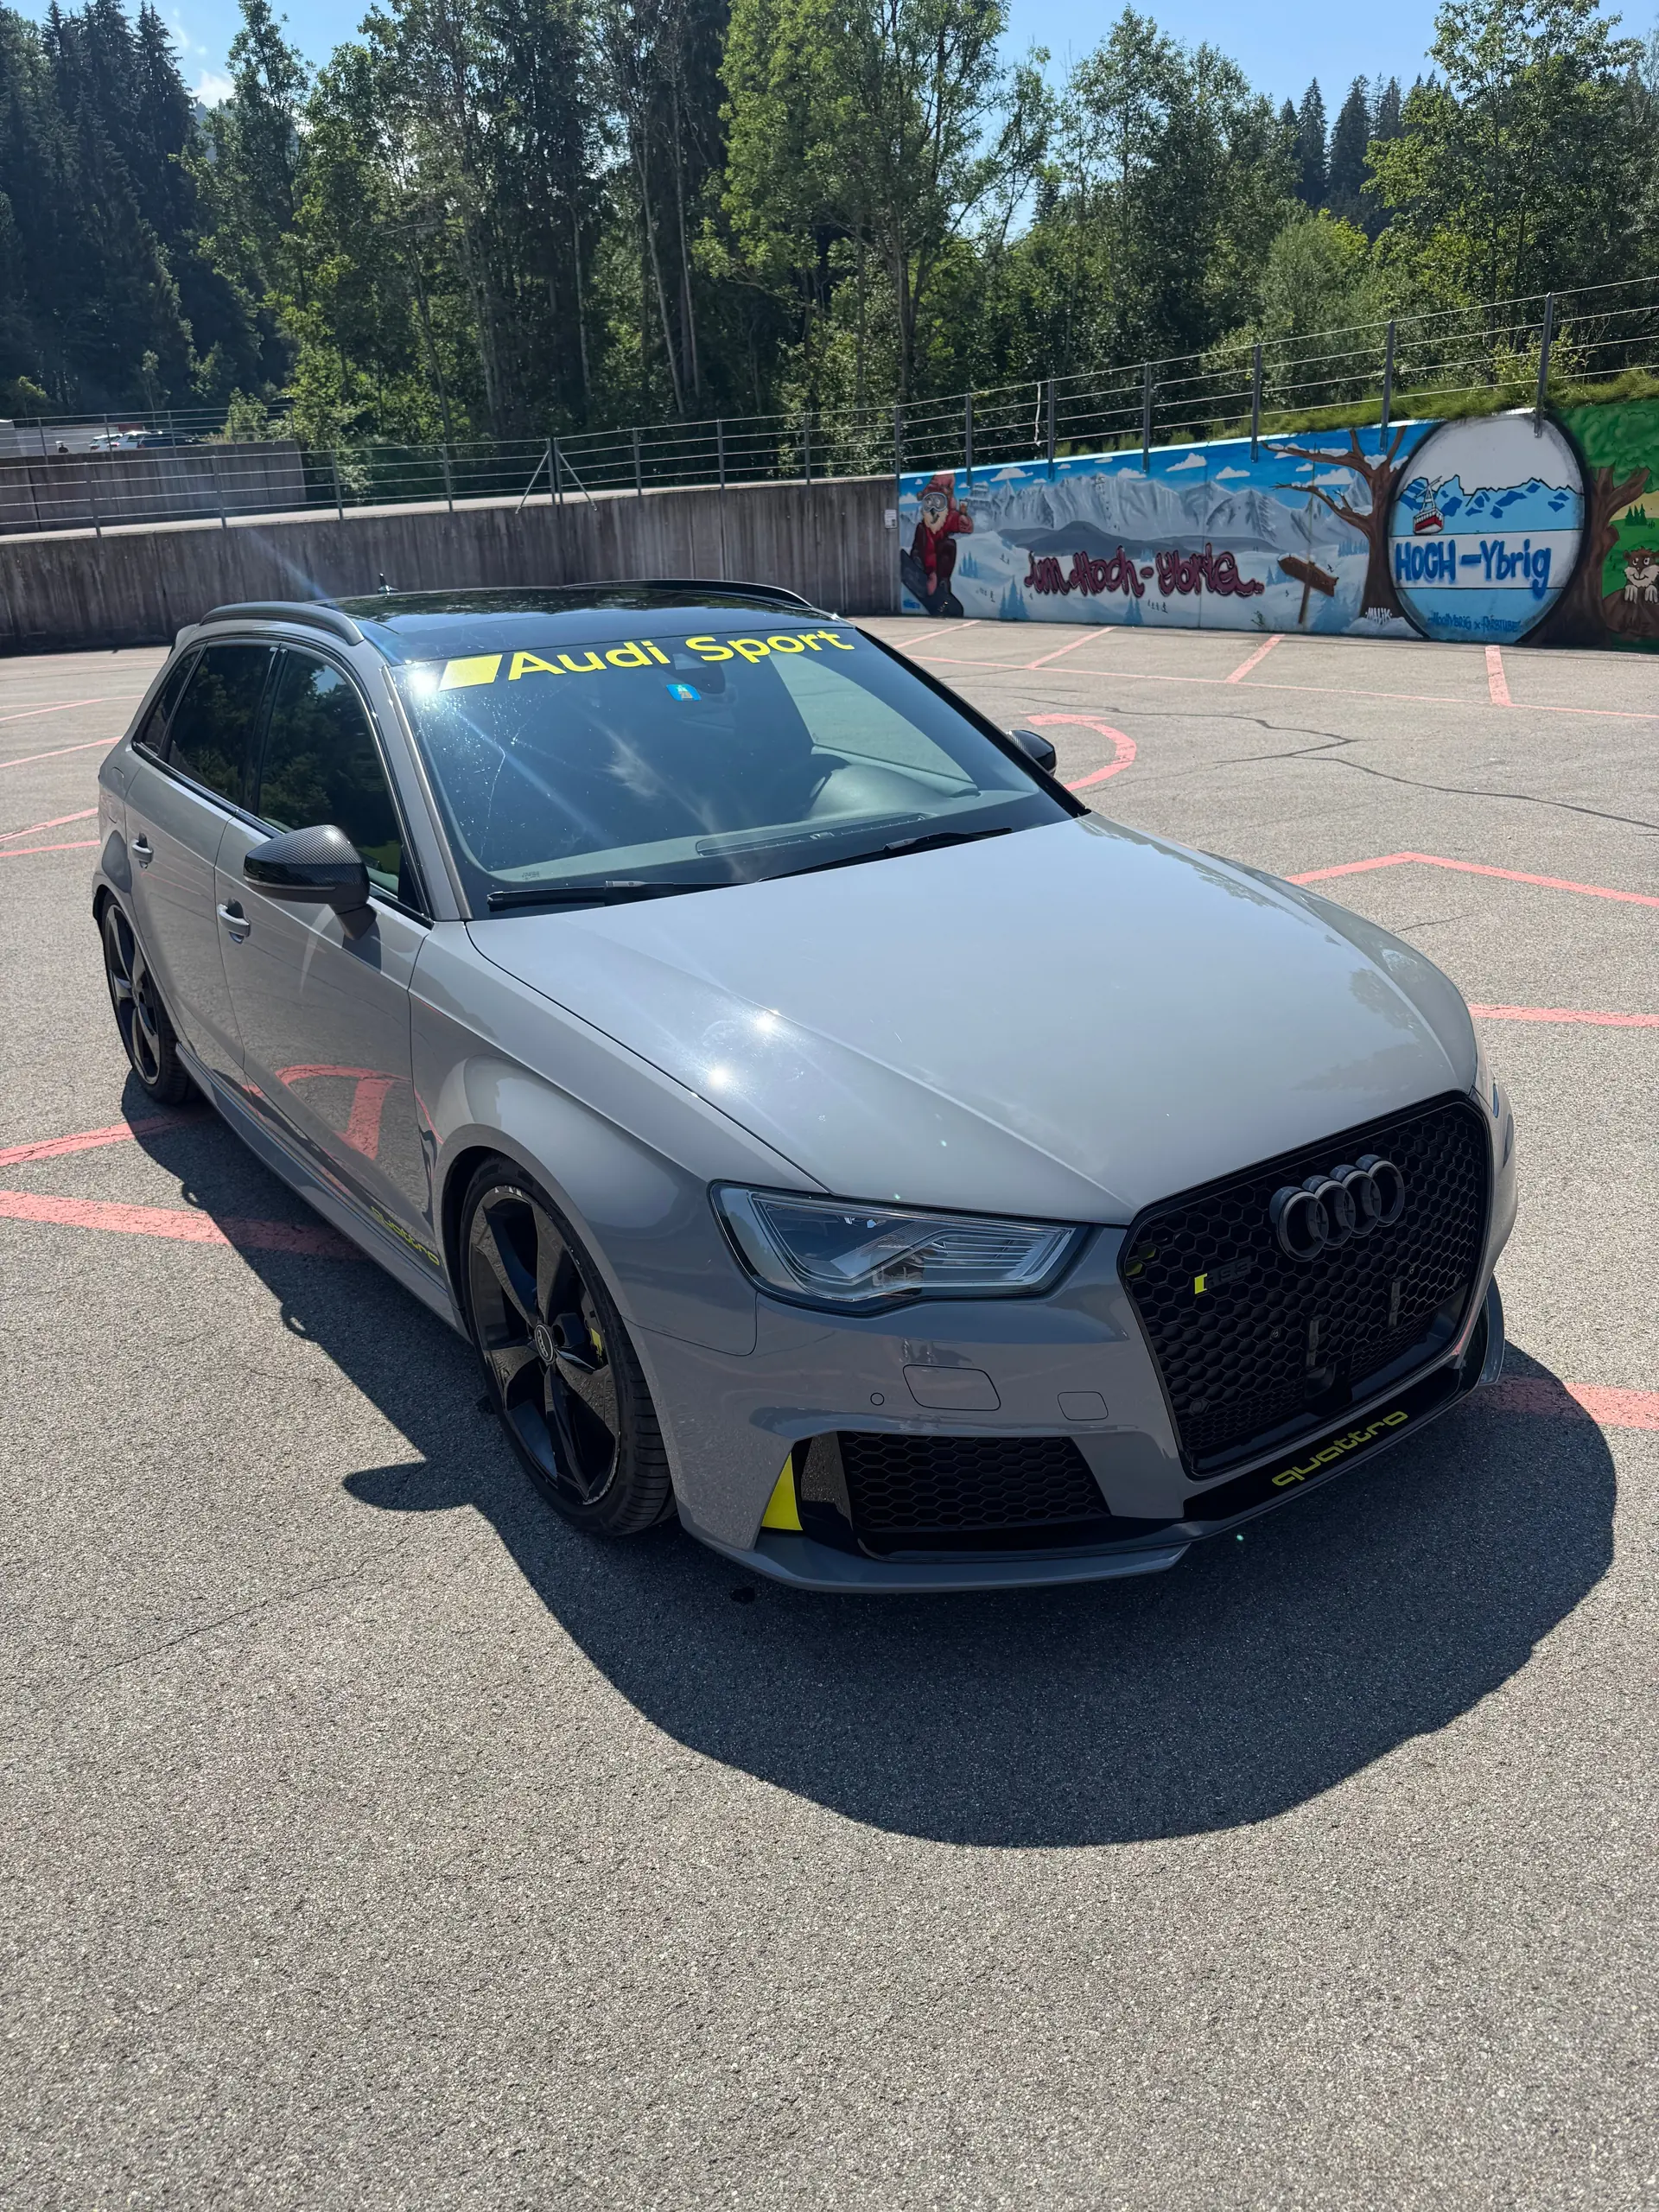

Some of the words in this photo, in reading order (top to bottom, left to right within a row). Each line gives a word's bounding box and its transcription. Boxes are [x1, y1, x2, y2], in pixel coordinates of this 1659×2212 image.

[509, 641, 671, 680] Audi
[685, 631, 855, 664] Sport
[1271, 1410, 1408, 1486] quattro
